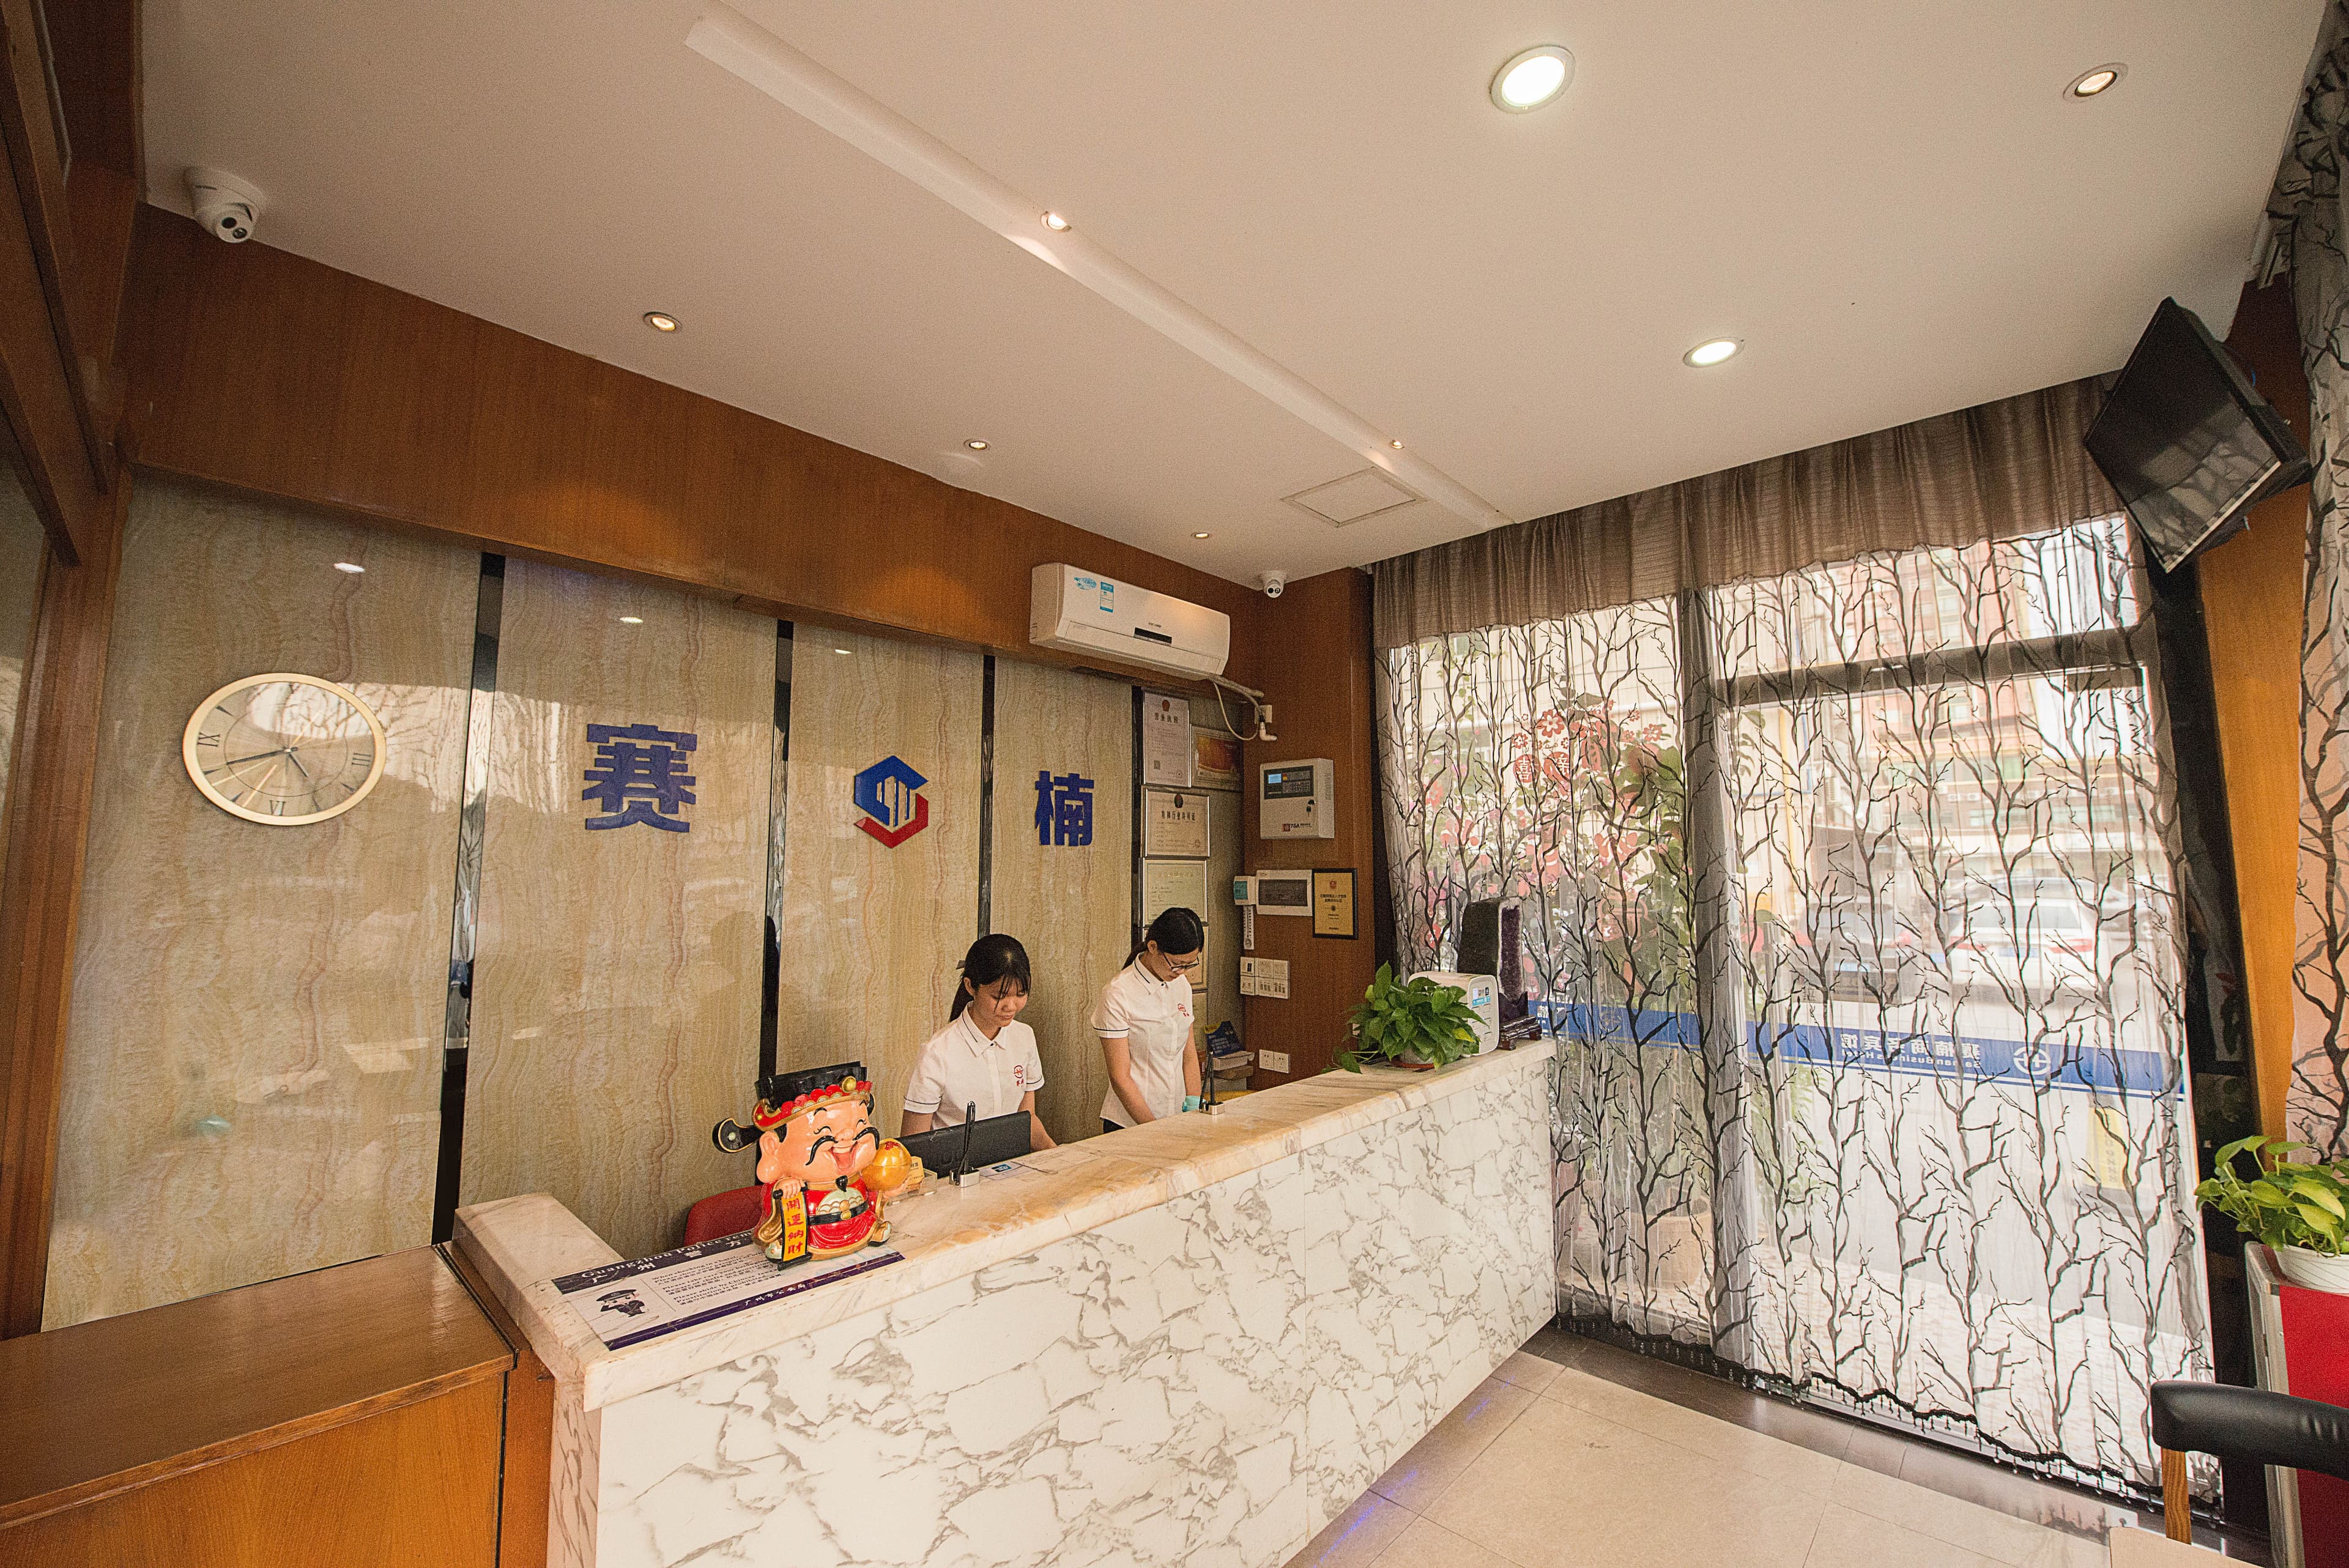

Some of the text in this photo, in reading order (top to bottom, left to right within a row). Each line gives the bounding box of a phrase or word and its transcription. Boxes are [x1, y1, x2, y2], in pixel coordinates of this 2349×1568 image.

[582, 724, 1094, 847] 赛 楠
[787, 1198, 804, 1254] 開運納財
[581, 1252, 672, 1278] Guangzhou
[676, 1239, 722, 1254] Police
